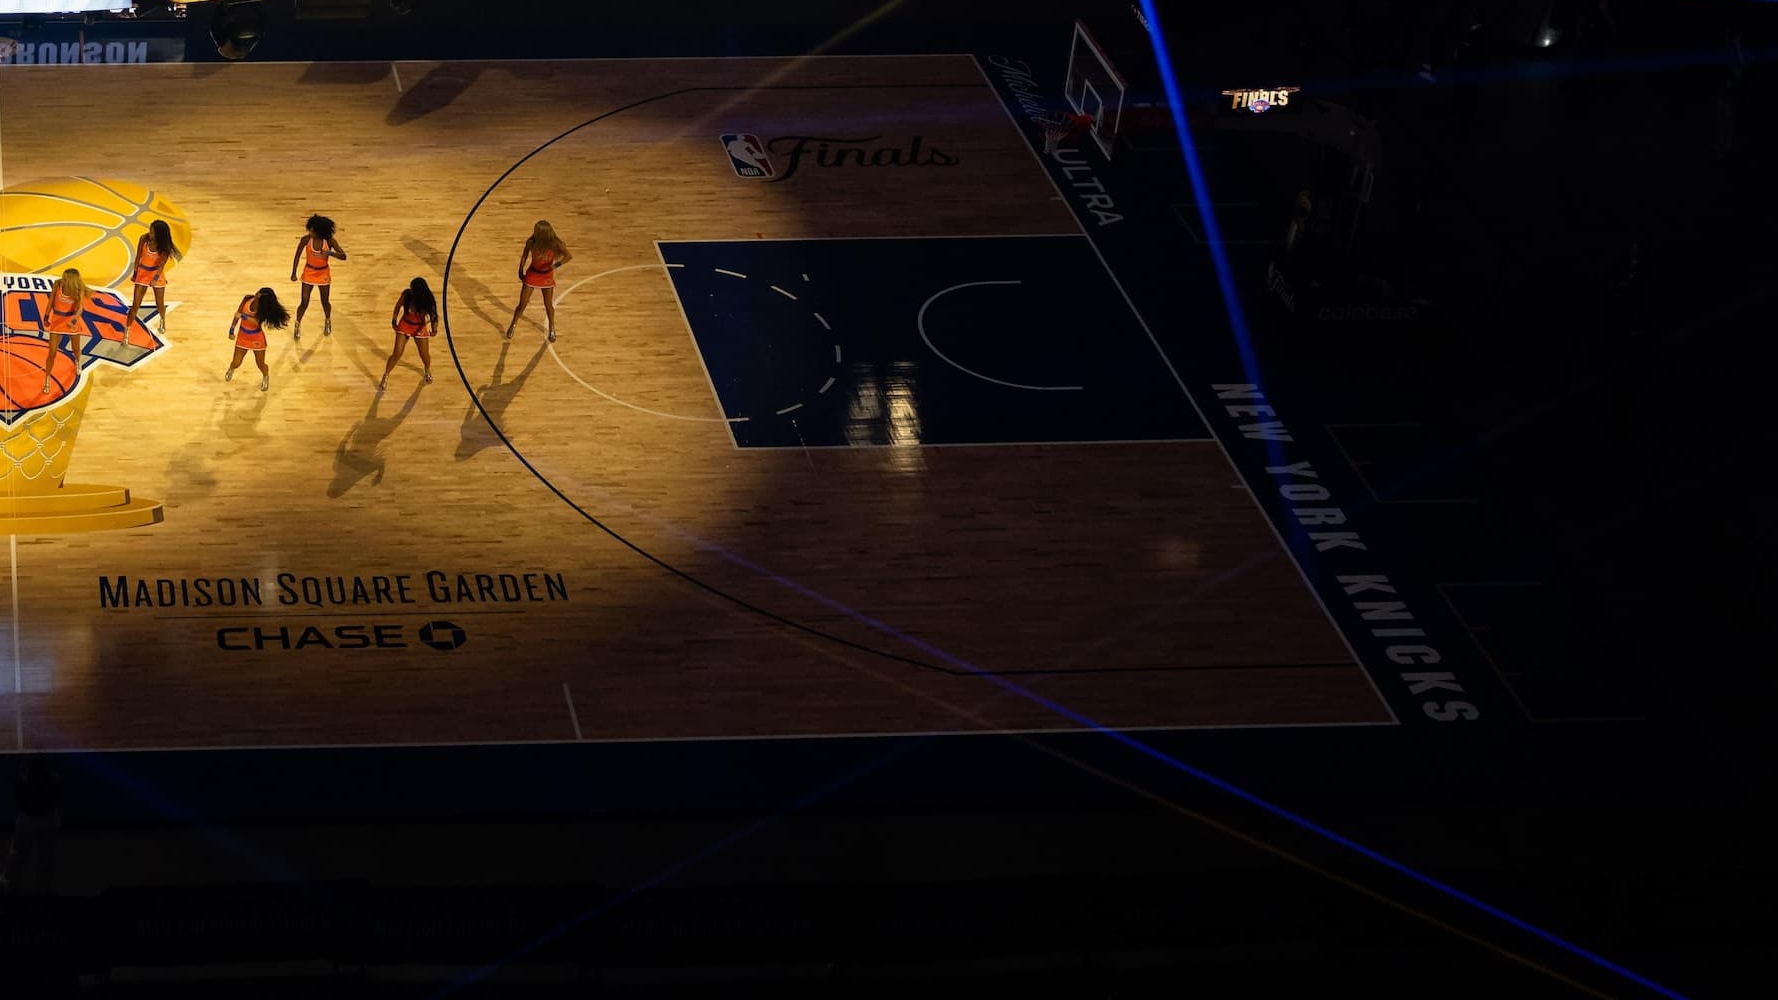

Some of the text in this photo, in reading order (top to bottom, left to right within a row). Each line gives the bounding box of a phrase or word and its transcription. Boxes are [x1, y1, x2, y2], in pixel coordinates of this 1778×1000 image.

[1231, 89, 1289, 110] FINALS
[761, 134, 960, 183] Finals
[1050, 148, 1125, 228] ULTRA
[1209, 382, 1481, 722] NEW YORK KNICKS
[99, 569, 569, 609] MADISON SQUARE GARDEN
[216, 625, 409, 651] CHASE
